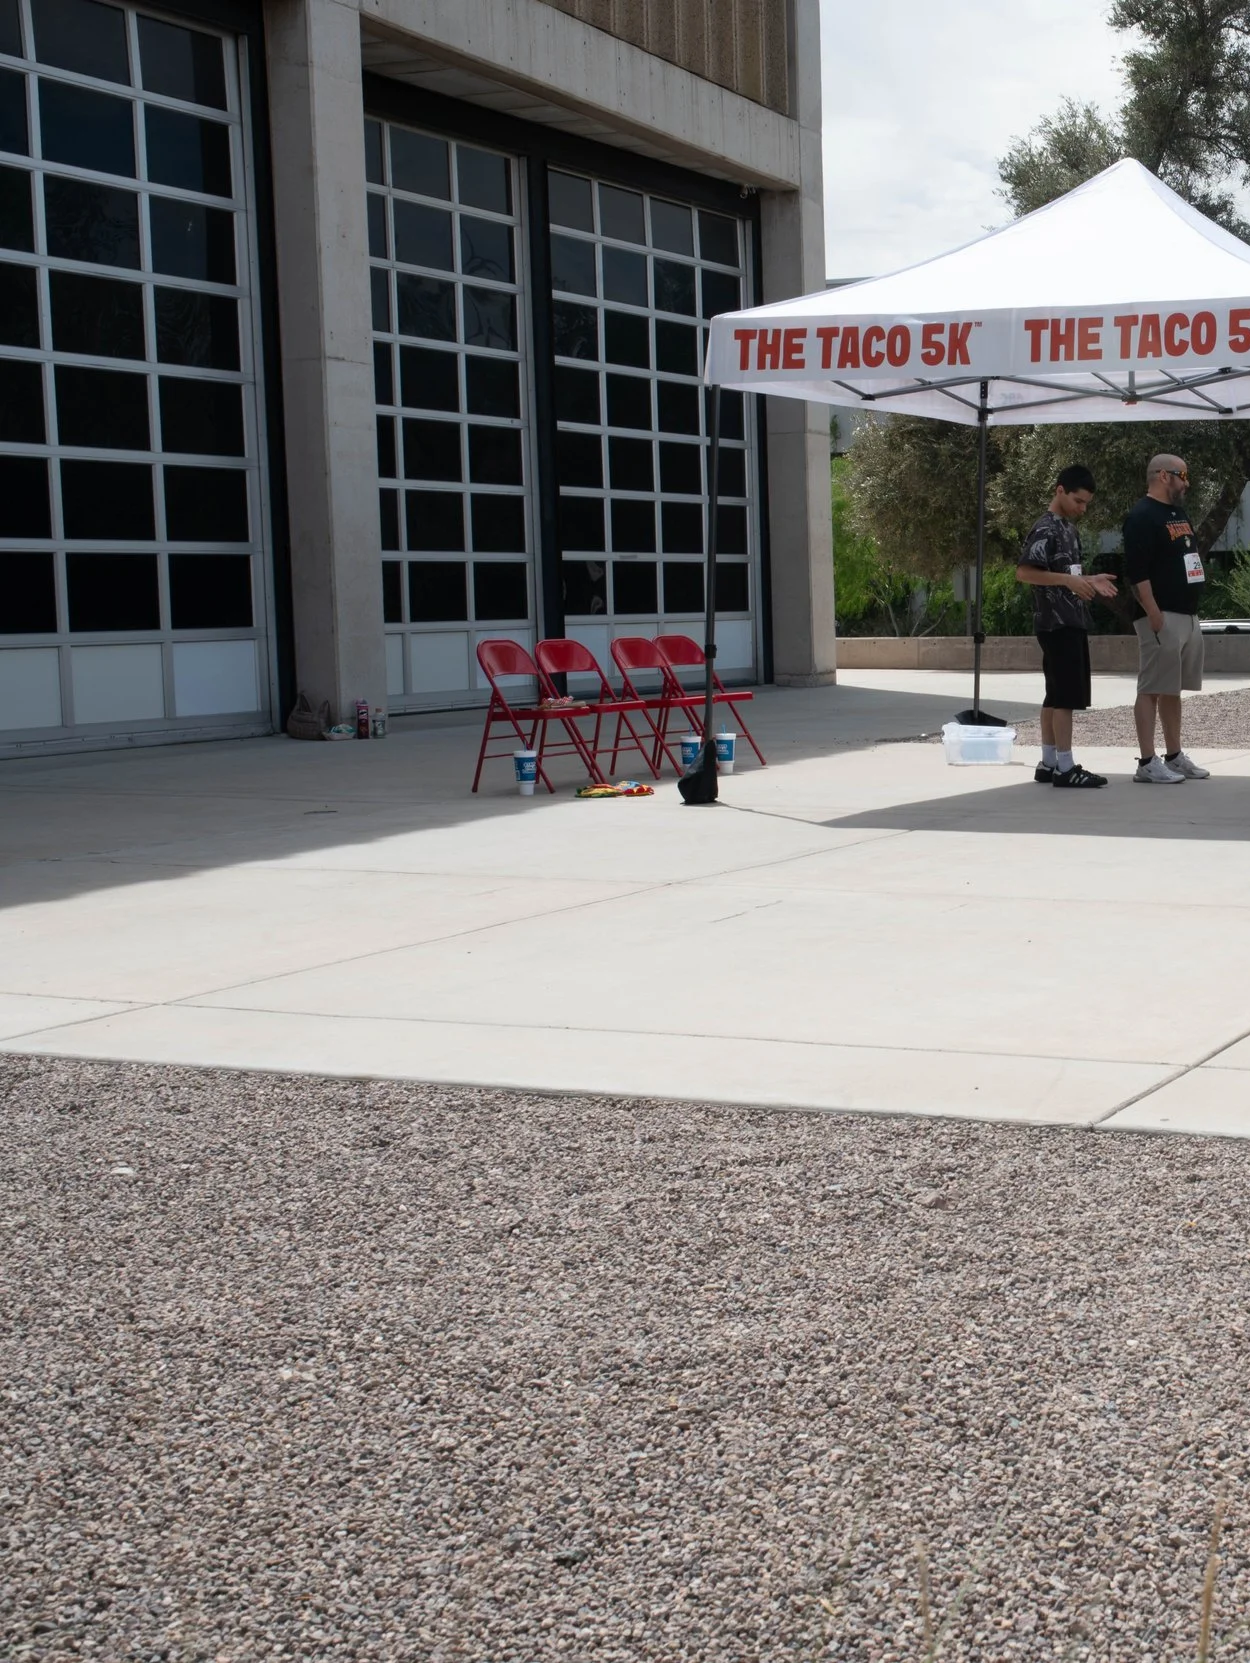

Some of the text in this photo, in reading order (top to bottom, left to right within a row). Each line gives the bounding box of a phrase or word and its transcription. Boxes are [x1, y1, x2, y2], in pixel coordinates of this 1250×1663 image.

[734, 326, 808, 371] THE
[817, 324, 911, 369] TACO
[1024, 317, 1103, 363] THE
[1114, 312, 1217, 360] TACO
